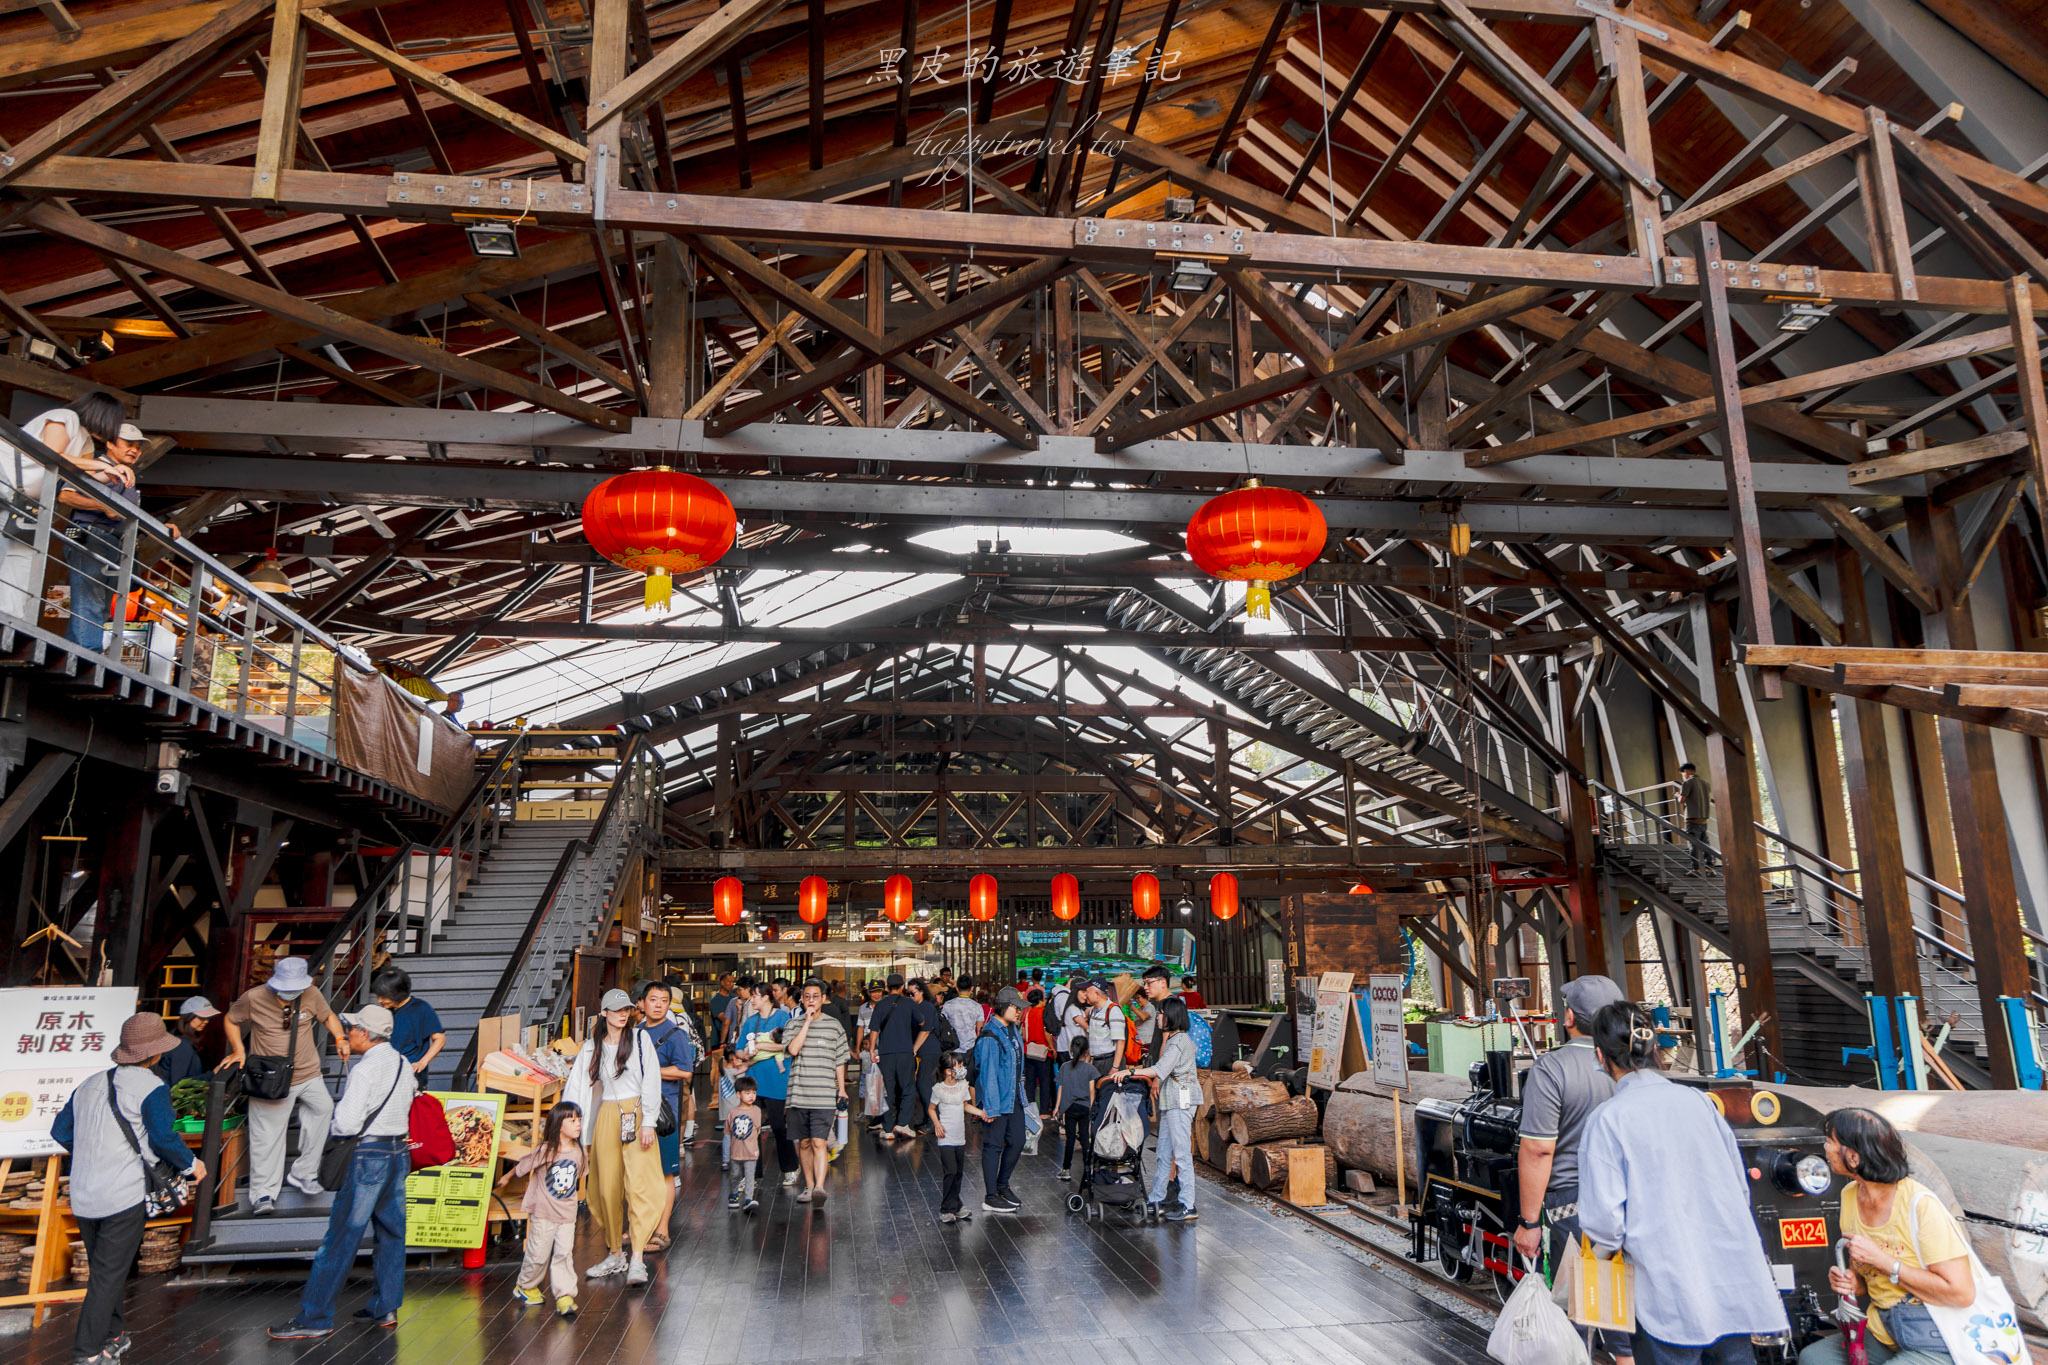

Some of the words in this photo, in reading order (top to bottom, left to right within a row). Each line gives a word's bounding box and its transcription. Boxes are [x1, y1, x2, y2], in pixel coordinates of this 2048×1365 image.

[35, 1010, 95, 1030] 原木
[16, 1031, 106, 1054] 剝皮秀
[37, 1093, 65, 1104] 早上
[1, 1108, 25, 1117] 六日
